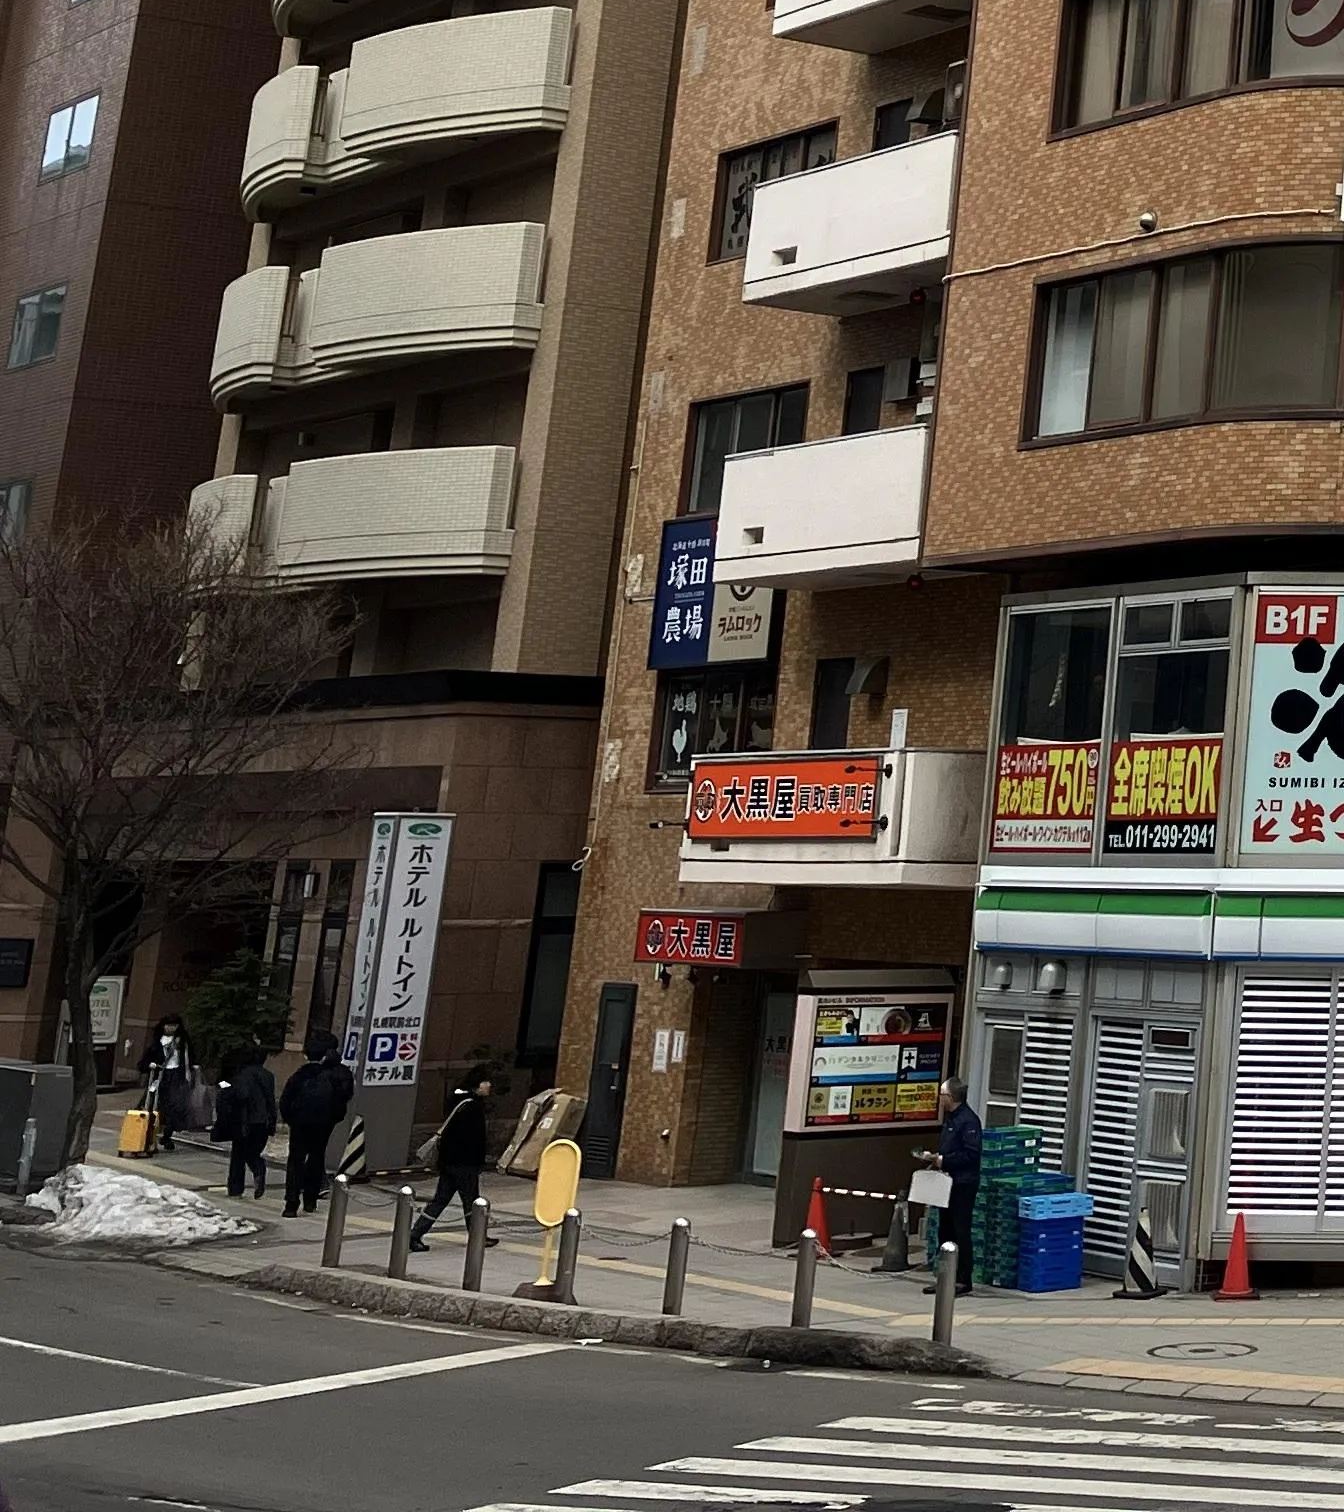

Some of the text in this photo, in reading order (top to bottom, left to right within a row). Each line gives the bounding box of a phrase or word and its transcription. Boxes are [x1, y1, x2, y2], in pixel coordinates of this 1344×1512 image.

[667, 553, 708, 590] 塚田
[662, 605, 704, 643] 農場
[718, 614, 762, 637] ラムロック
[1264, 604, 1330, 636] B1F
[719, 776, 876, 823] 大黒屋 買取専門店
[1110, 745, 1222, 817] 全席喫煙OK
[1268, 776, 1326, 789] SUMIBI
[1254, 798, 1283, 813] 入口
[388, 844, 434, 1013] ホテル ルートイン
[667, 918, 737, 960] 大黒屋
[374, 1036, 394, 1061] P
